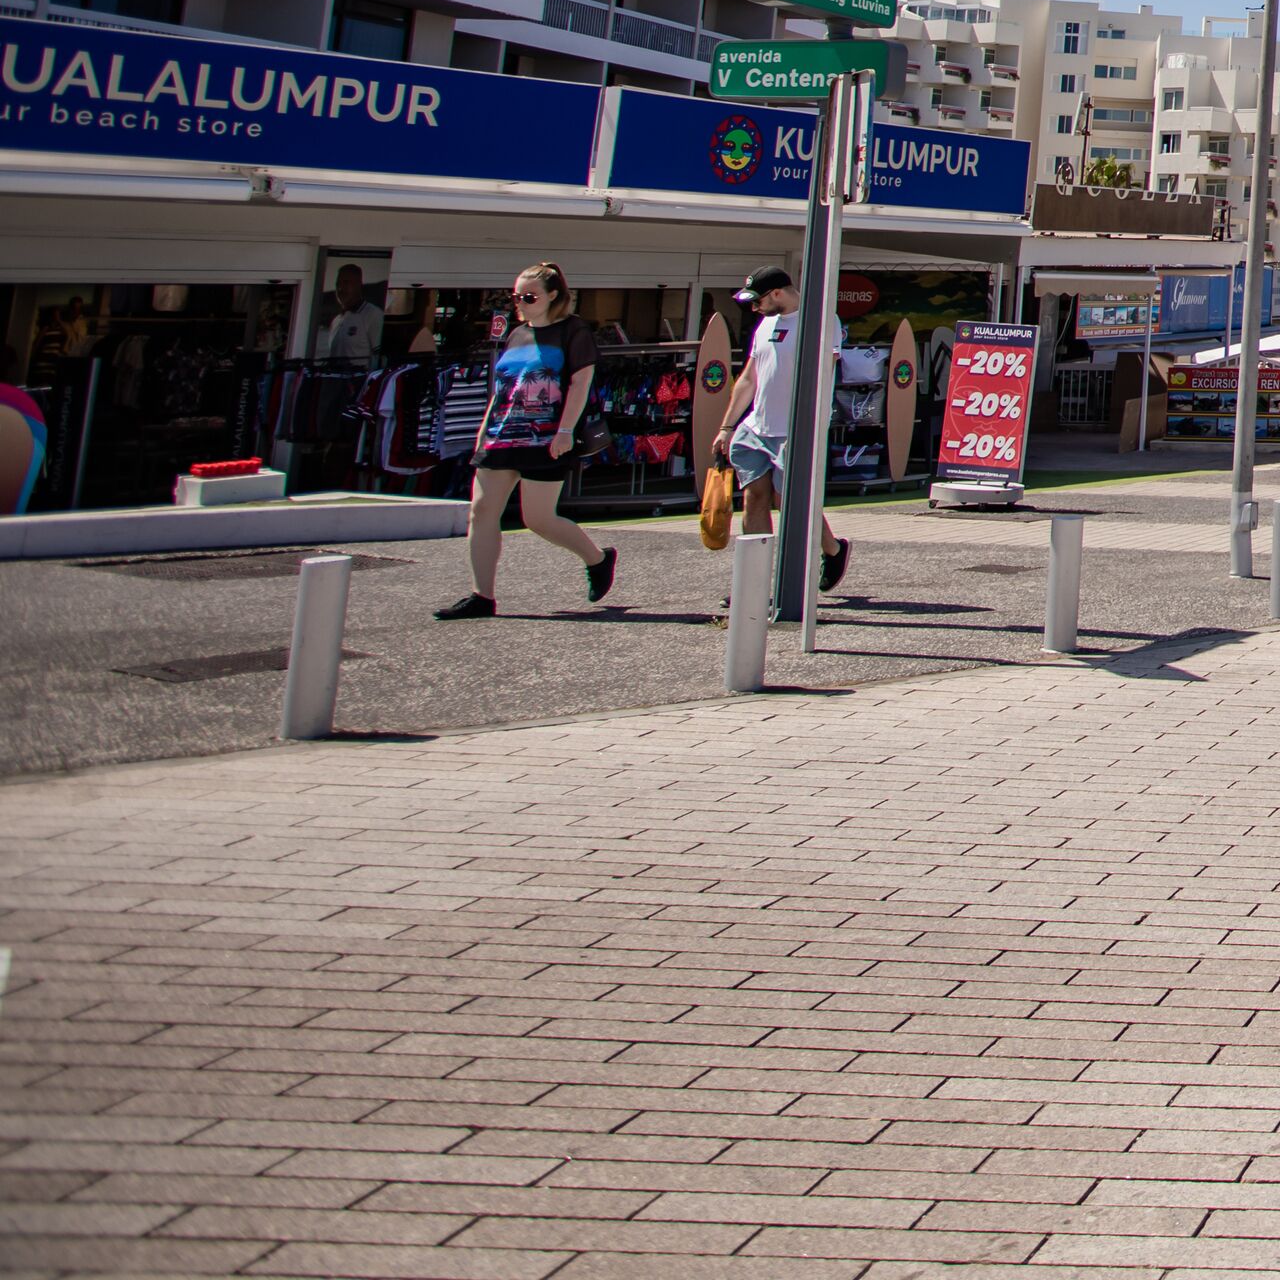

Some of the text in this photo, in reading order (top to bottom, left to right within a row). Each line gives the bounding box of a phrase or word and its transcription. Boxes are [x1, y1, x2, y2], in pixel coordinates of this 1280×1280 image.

[719, 49, 782, 64] avenida
[0, 43, 441, 127] UALALUMPUR
[717, 67, 846, 88] V Centena
[50, 102, 159, 131] beach
[177, 116, 263, 138] store
[773, 125, 980, 177] KULUMPUR
[772, 164, 809, 182] your
[838, 291, 873, 303] aianas
[1171, 276, 1207, 311] Glamour
[974, 326, 1033, 339] KUALALUMPUR
[956, 350, 1027, 378] -20%
[1191, 378, 1238, 389] EXCURSIO
[232, 377, 250, 459] ALALUMPUR
[951, 391, 1022, 419] -20%
[946, 432, 1016, 461] -20%
